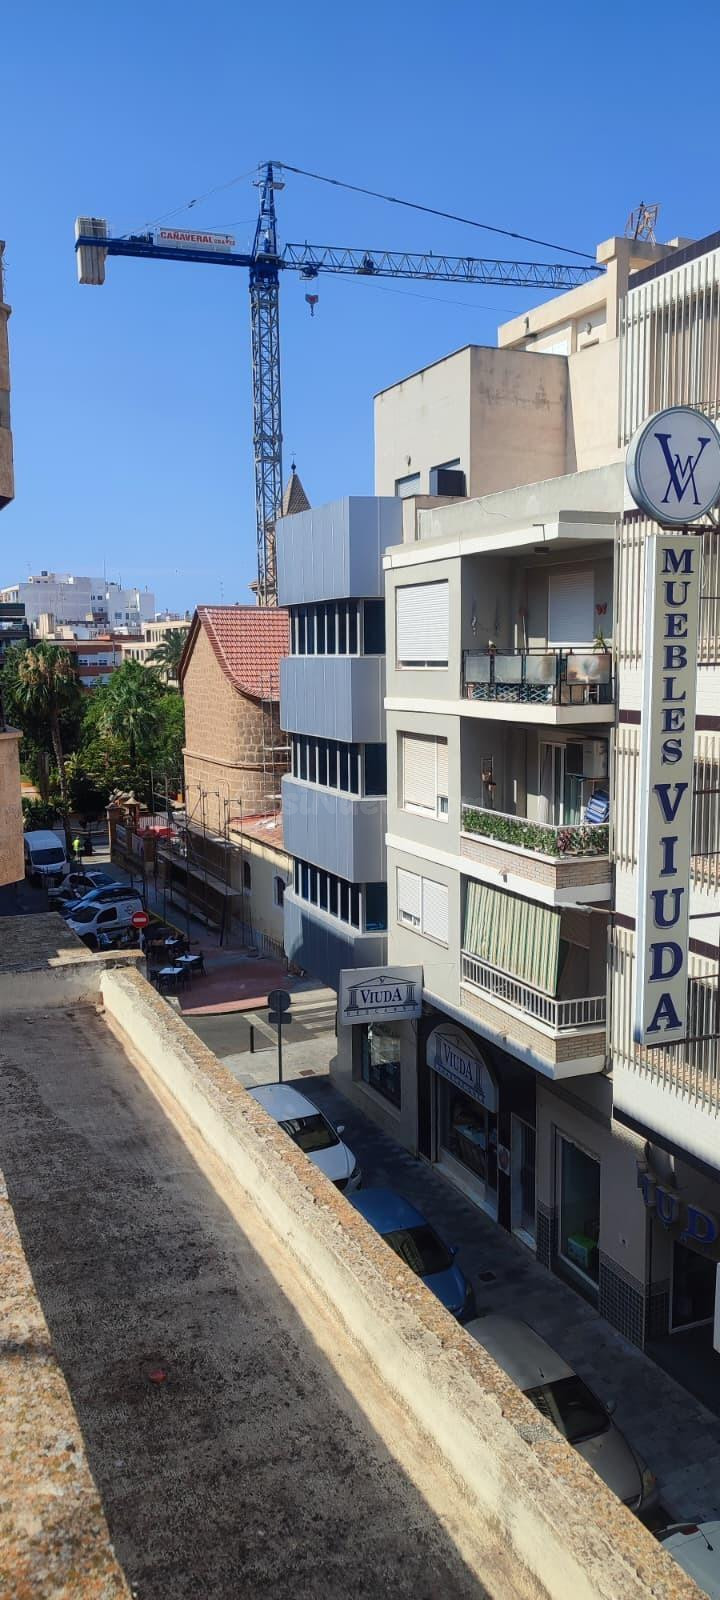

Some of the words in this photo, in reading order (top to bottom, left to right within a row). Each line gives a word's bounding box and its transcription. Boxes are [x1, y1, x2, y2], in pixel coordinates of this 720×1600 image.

[660, 548, 695, 765] MUEBLES
[646, 782, 688, 1033] VIUDA
[443, 1042, 474, 1081] VIUDA
